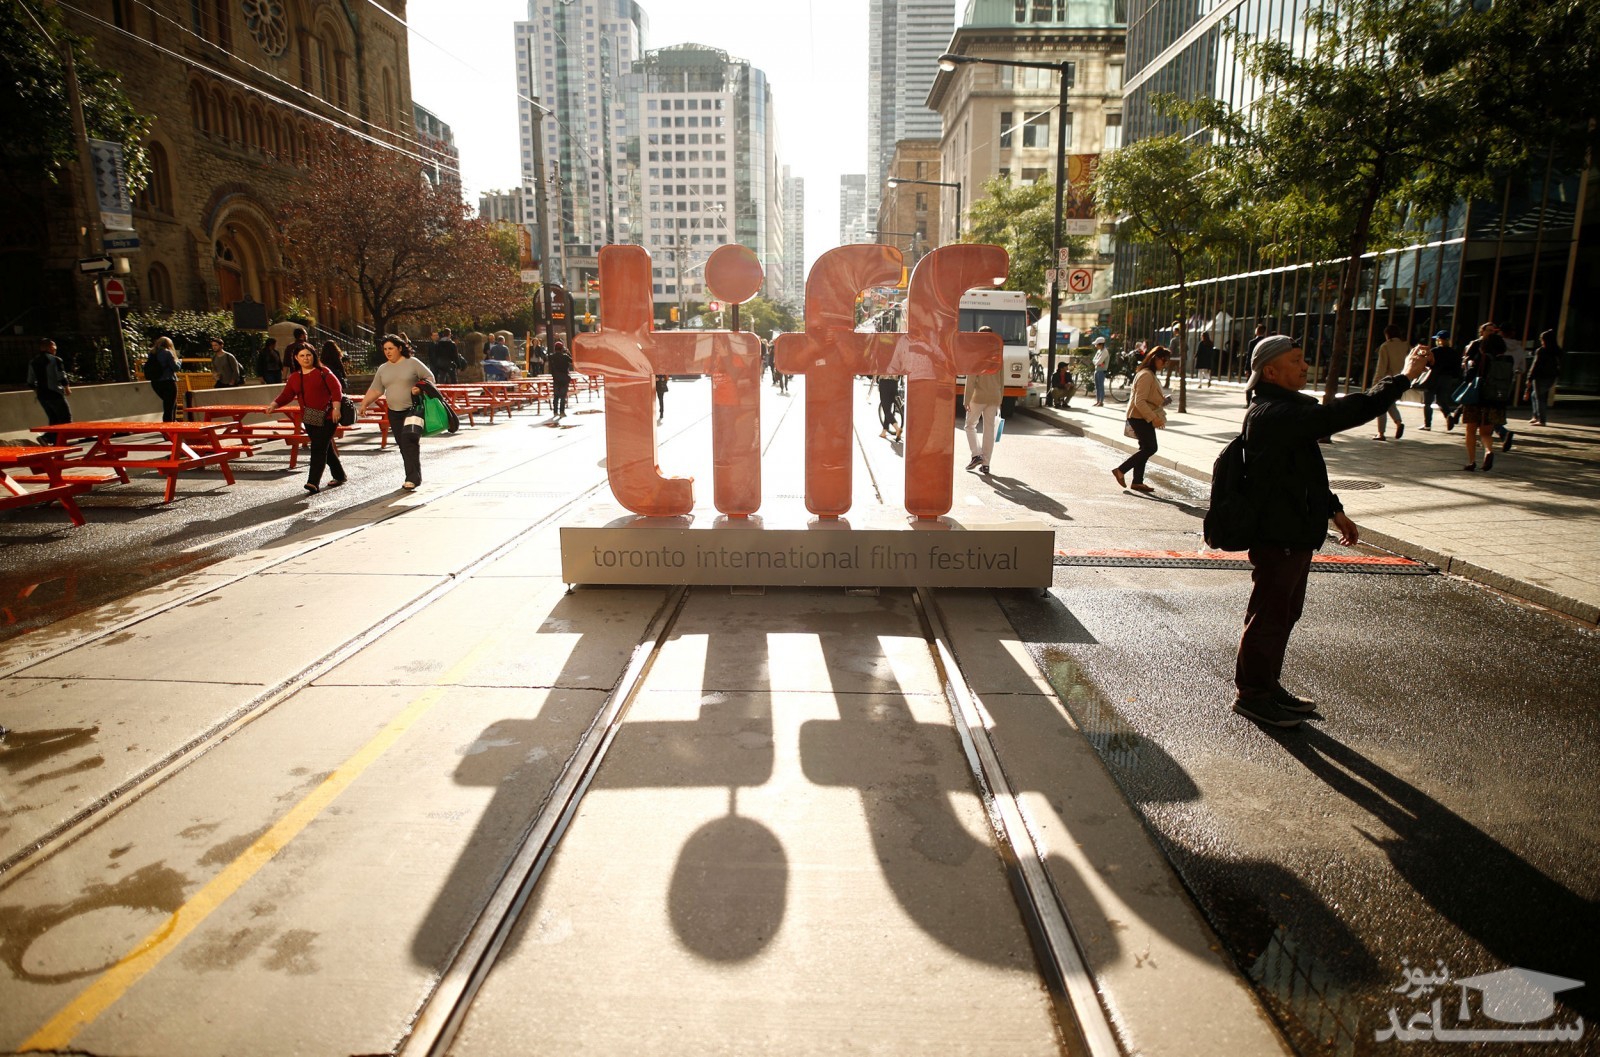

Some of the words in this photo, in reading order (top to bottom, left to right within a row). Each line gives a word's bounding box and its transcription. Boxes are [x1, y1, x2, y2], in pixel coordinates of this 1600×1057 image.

[572, 243, 1009, 517] tiff
[593, 545, 685, 568] toronto
[697, 545, 859, 569] international
[870, 545, 918, 570] film
[929, 546, 1018, 570] festival
